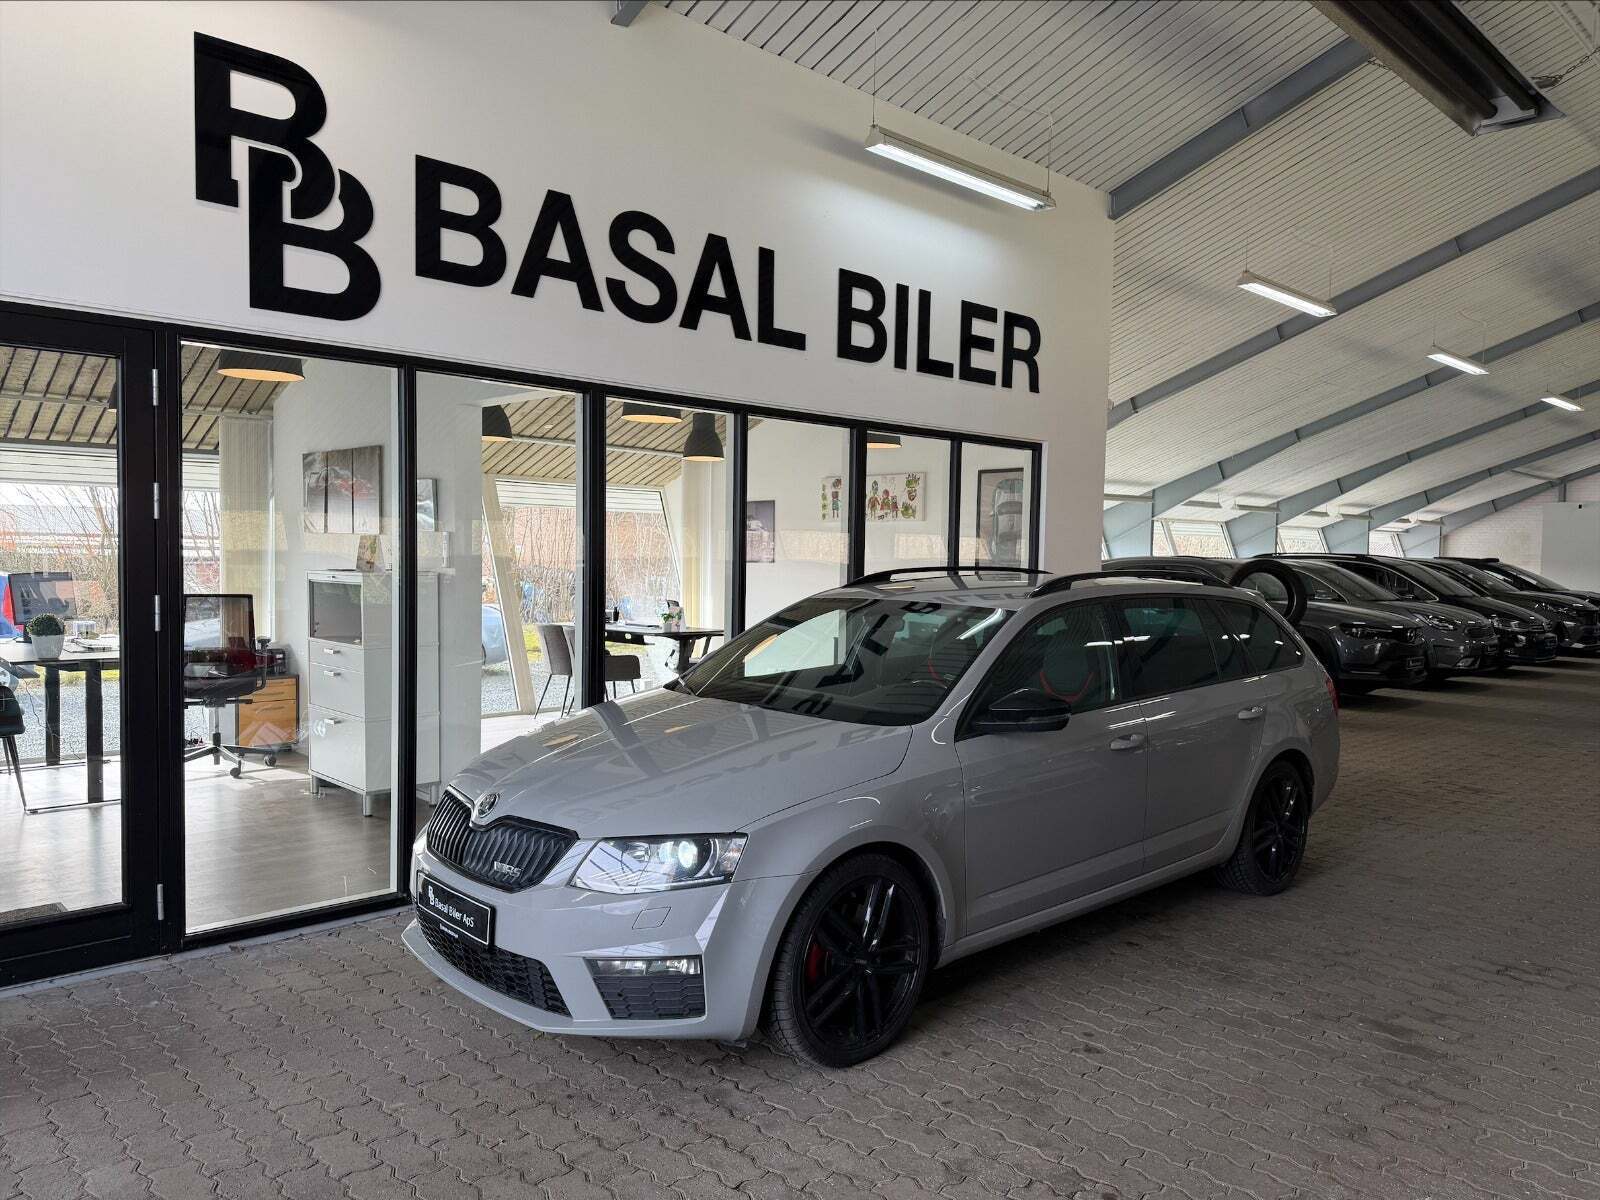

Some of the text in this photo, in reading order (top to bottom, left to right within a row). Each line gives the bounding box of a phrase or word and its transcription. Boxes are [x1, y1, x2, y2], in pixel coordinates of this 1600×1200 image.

[416, 155, 1040, 393] BASAL BILER
[434, 898, 474, 927] Basal Biler ApS
